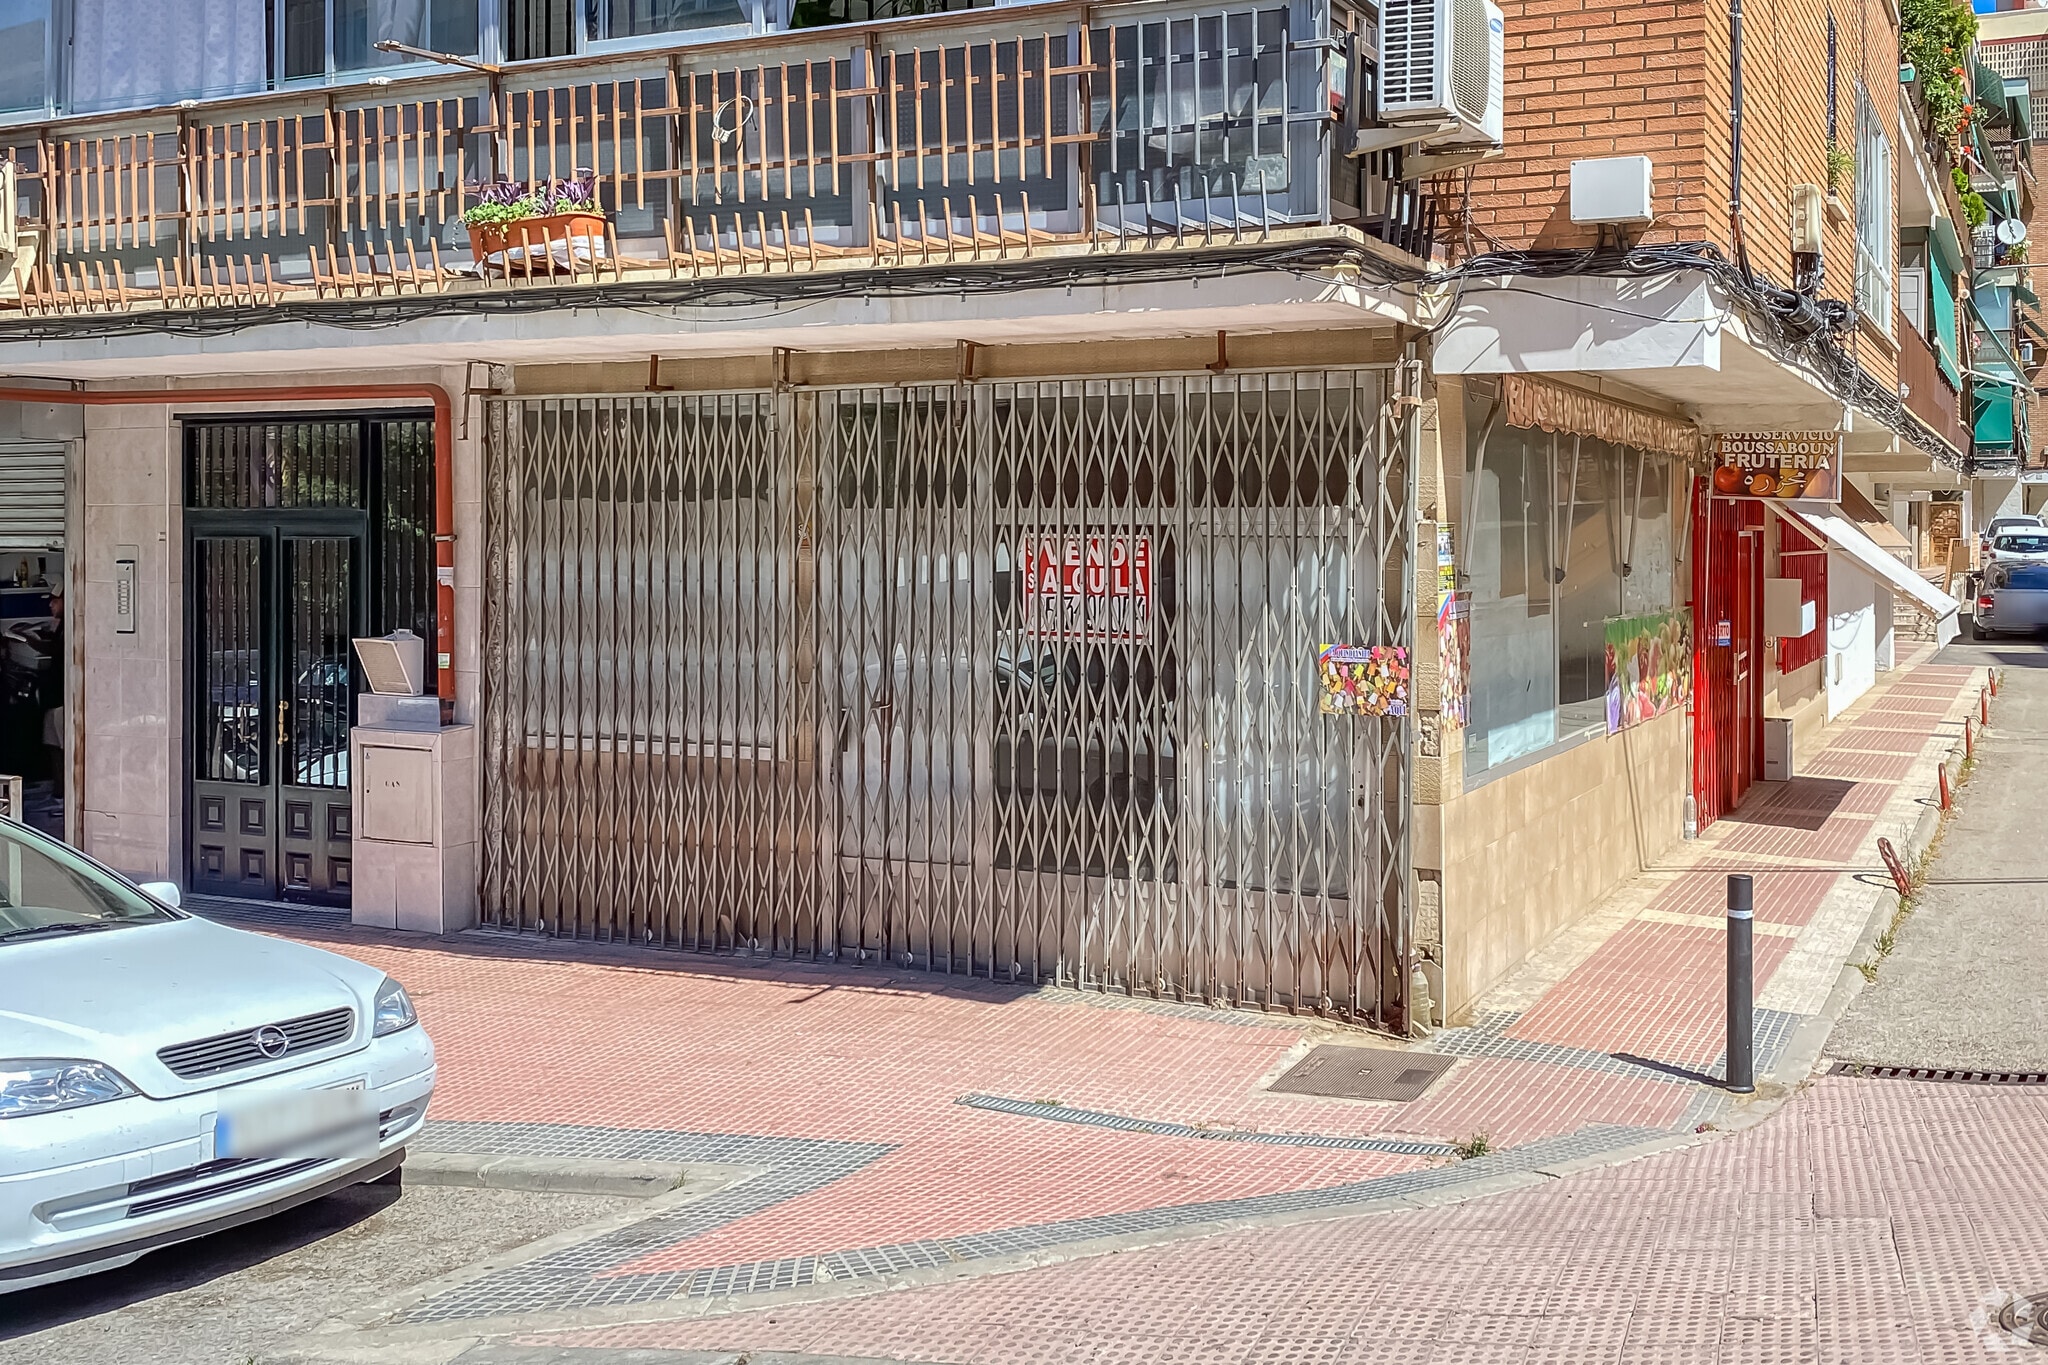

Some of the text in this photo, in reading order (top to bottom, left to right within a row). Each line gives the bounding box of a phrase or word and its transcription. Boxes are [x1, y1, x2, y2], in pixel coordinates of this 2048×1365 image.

[1721, 432, 1834, 440] AUTOSERVICIO
[1721, 441, 1834, 454] BOUSSABOUN
[1725, 453, 1830, 469] FRUTERIA
[1044, 541, 1146, 567] VENDE
[1042, 567, 1145, 594] AQULA
